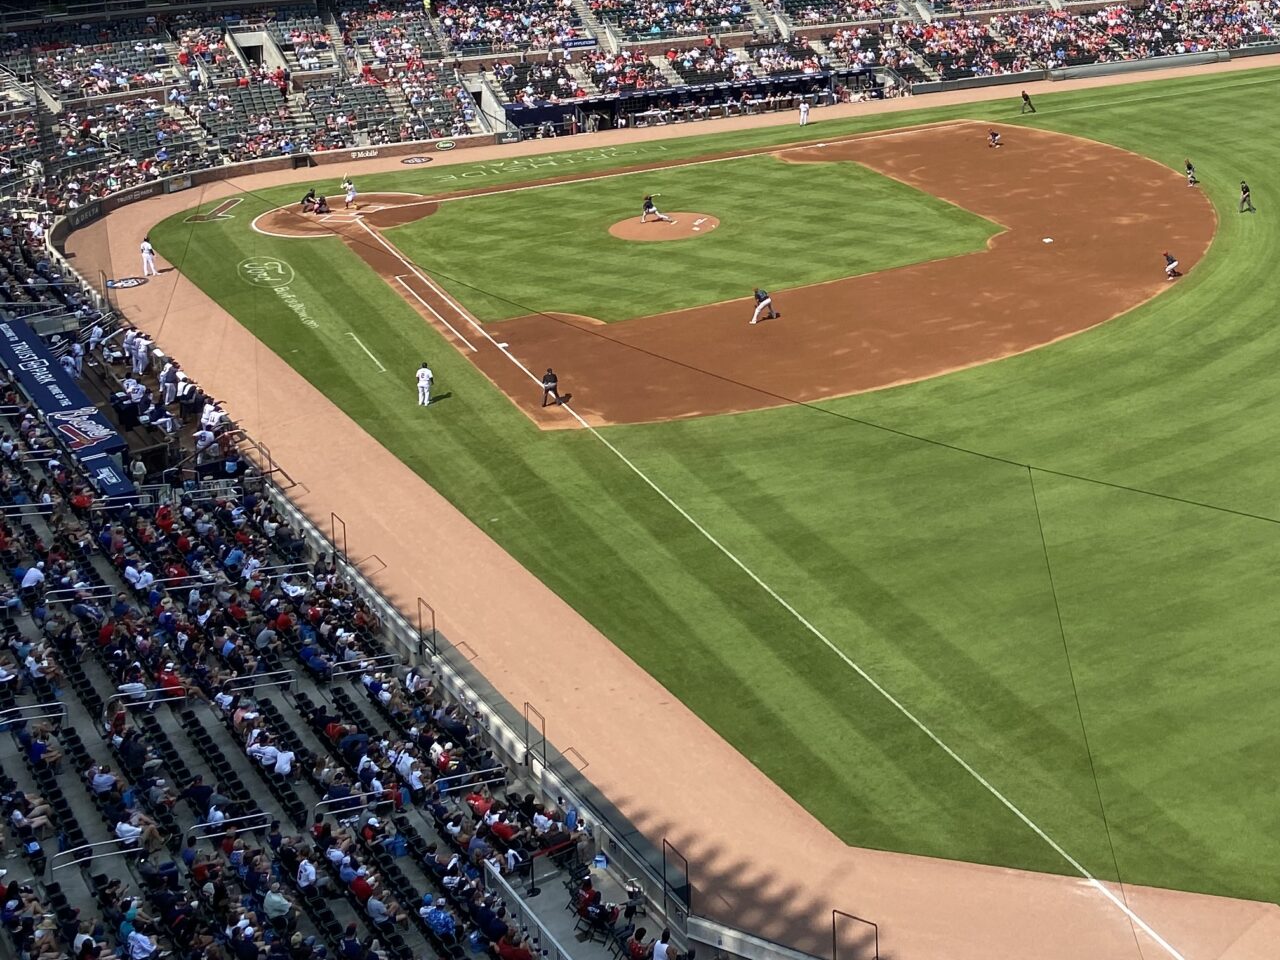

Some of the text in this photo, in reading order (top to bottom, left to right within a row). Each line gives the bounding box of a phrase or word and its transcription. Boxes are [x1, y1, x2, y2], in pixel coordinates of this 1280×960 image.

[433, 145, 667, 182] NORTHSIDE
[80, 207, 98, 220] DELTA
[243, 260, 286, 282] Ford
[30, 365, 57, 384] PARK
